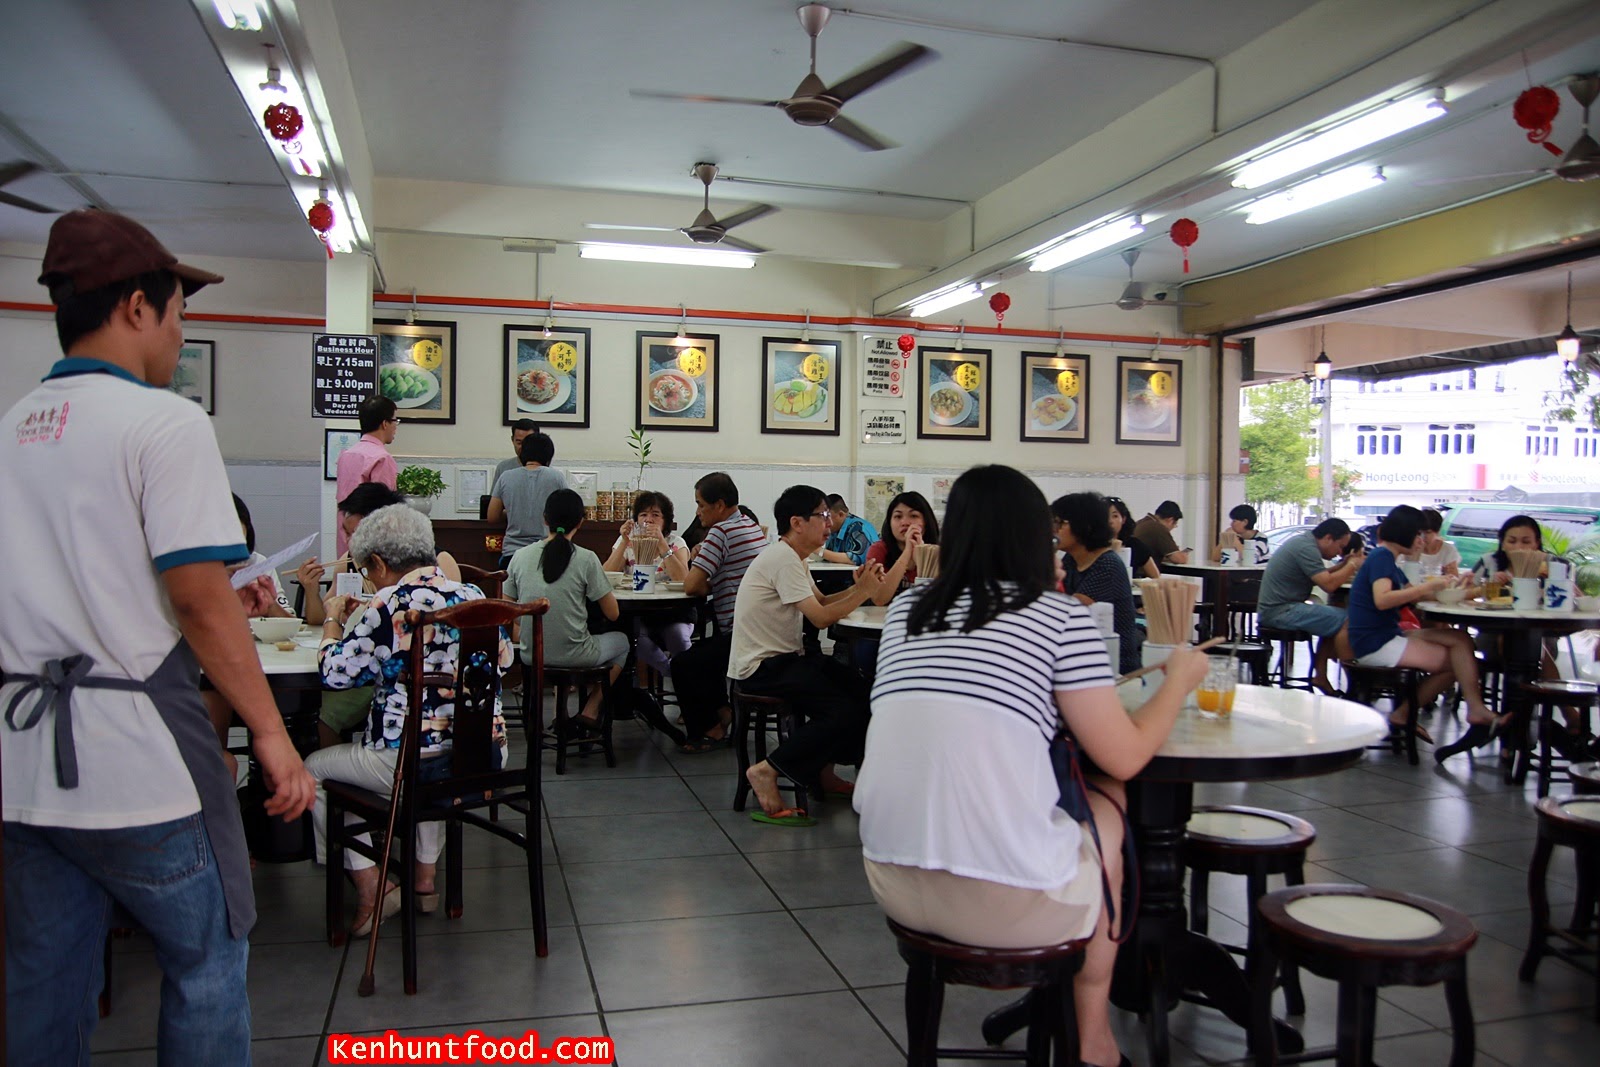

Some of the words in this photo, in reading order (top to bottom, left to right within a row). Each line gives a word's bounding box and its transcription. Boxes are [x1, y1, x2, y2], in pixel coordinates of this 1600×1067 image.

[316, 356, 333, 366] 早上
[335, 357, 374, 367] 7.15am
[335, 379, 374, 390] 9.00pm
